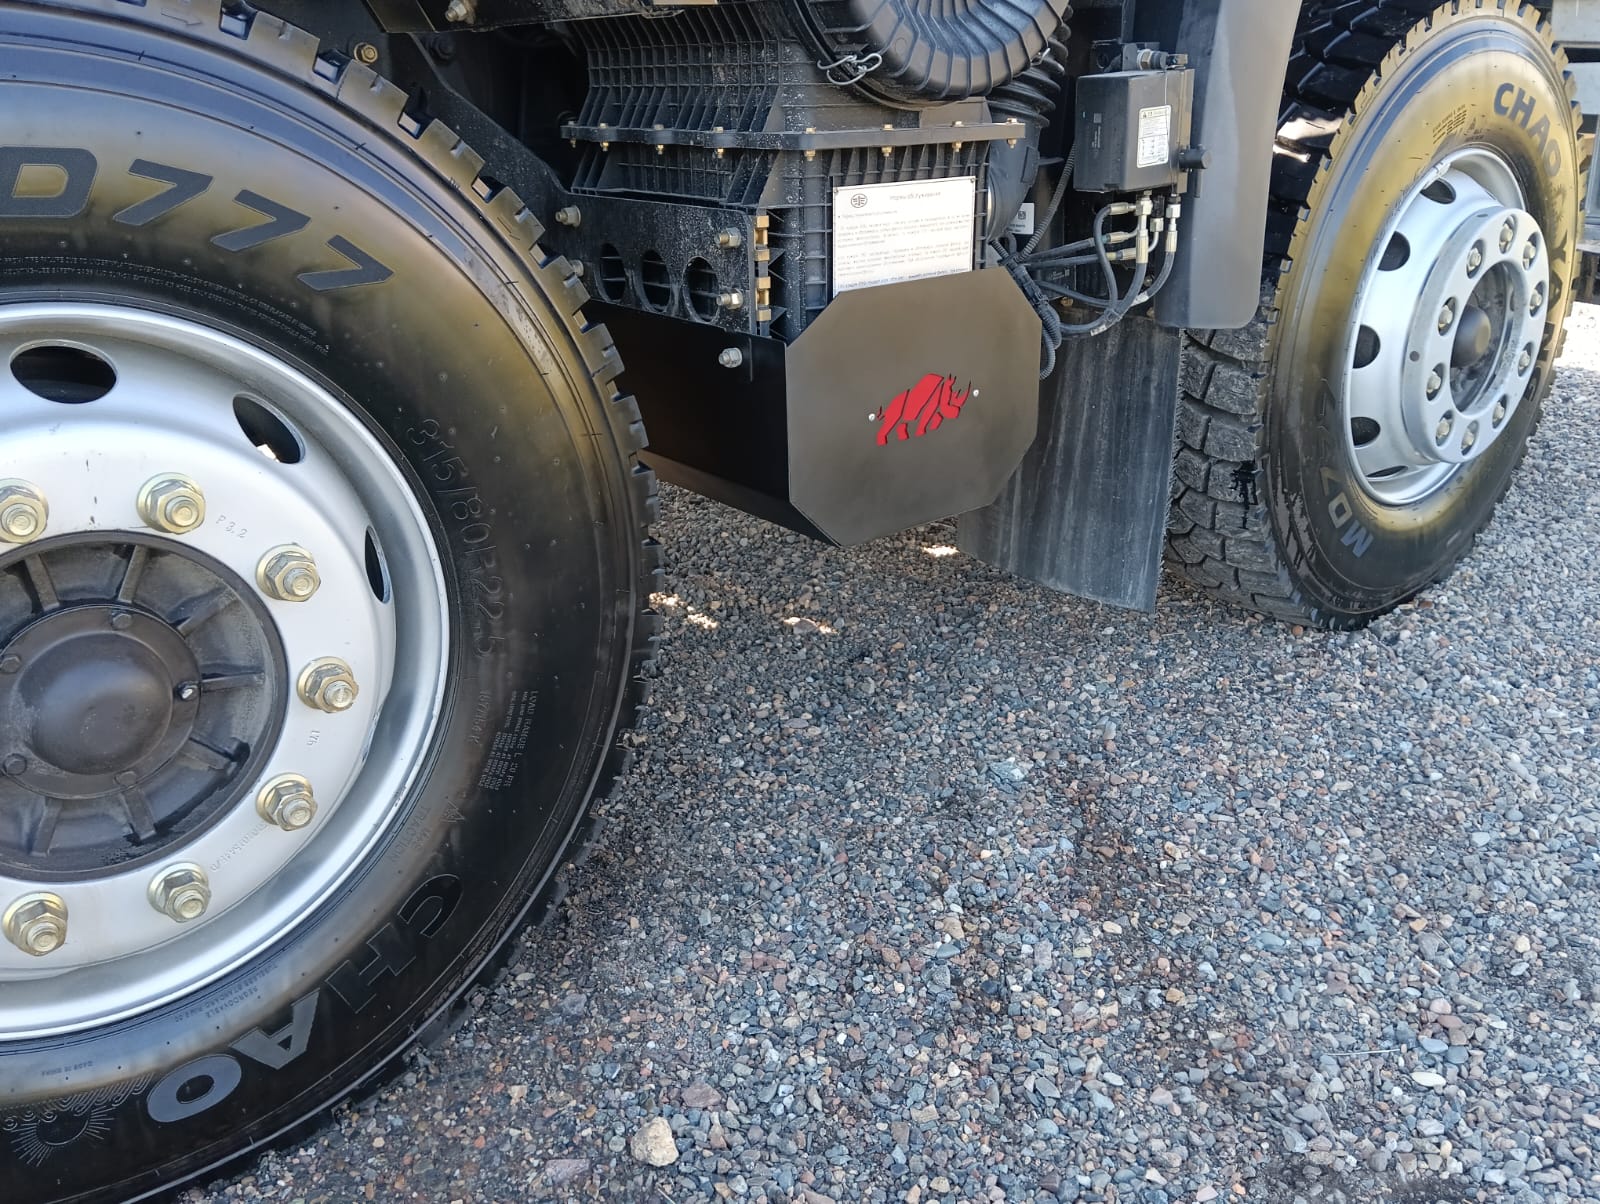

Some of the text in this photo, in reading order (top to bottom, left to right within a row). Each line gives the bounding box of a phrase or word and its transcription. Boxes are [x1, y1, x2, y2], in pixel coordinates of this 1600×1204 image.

[1493, 82, 1562, 177] CHAO
[0, 146, 395, 293] D777
[146, 873, 465, 1123] CHAO
